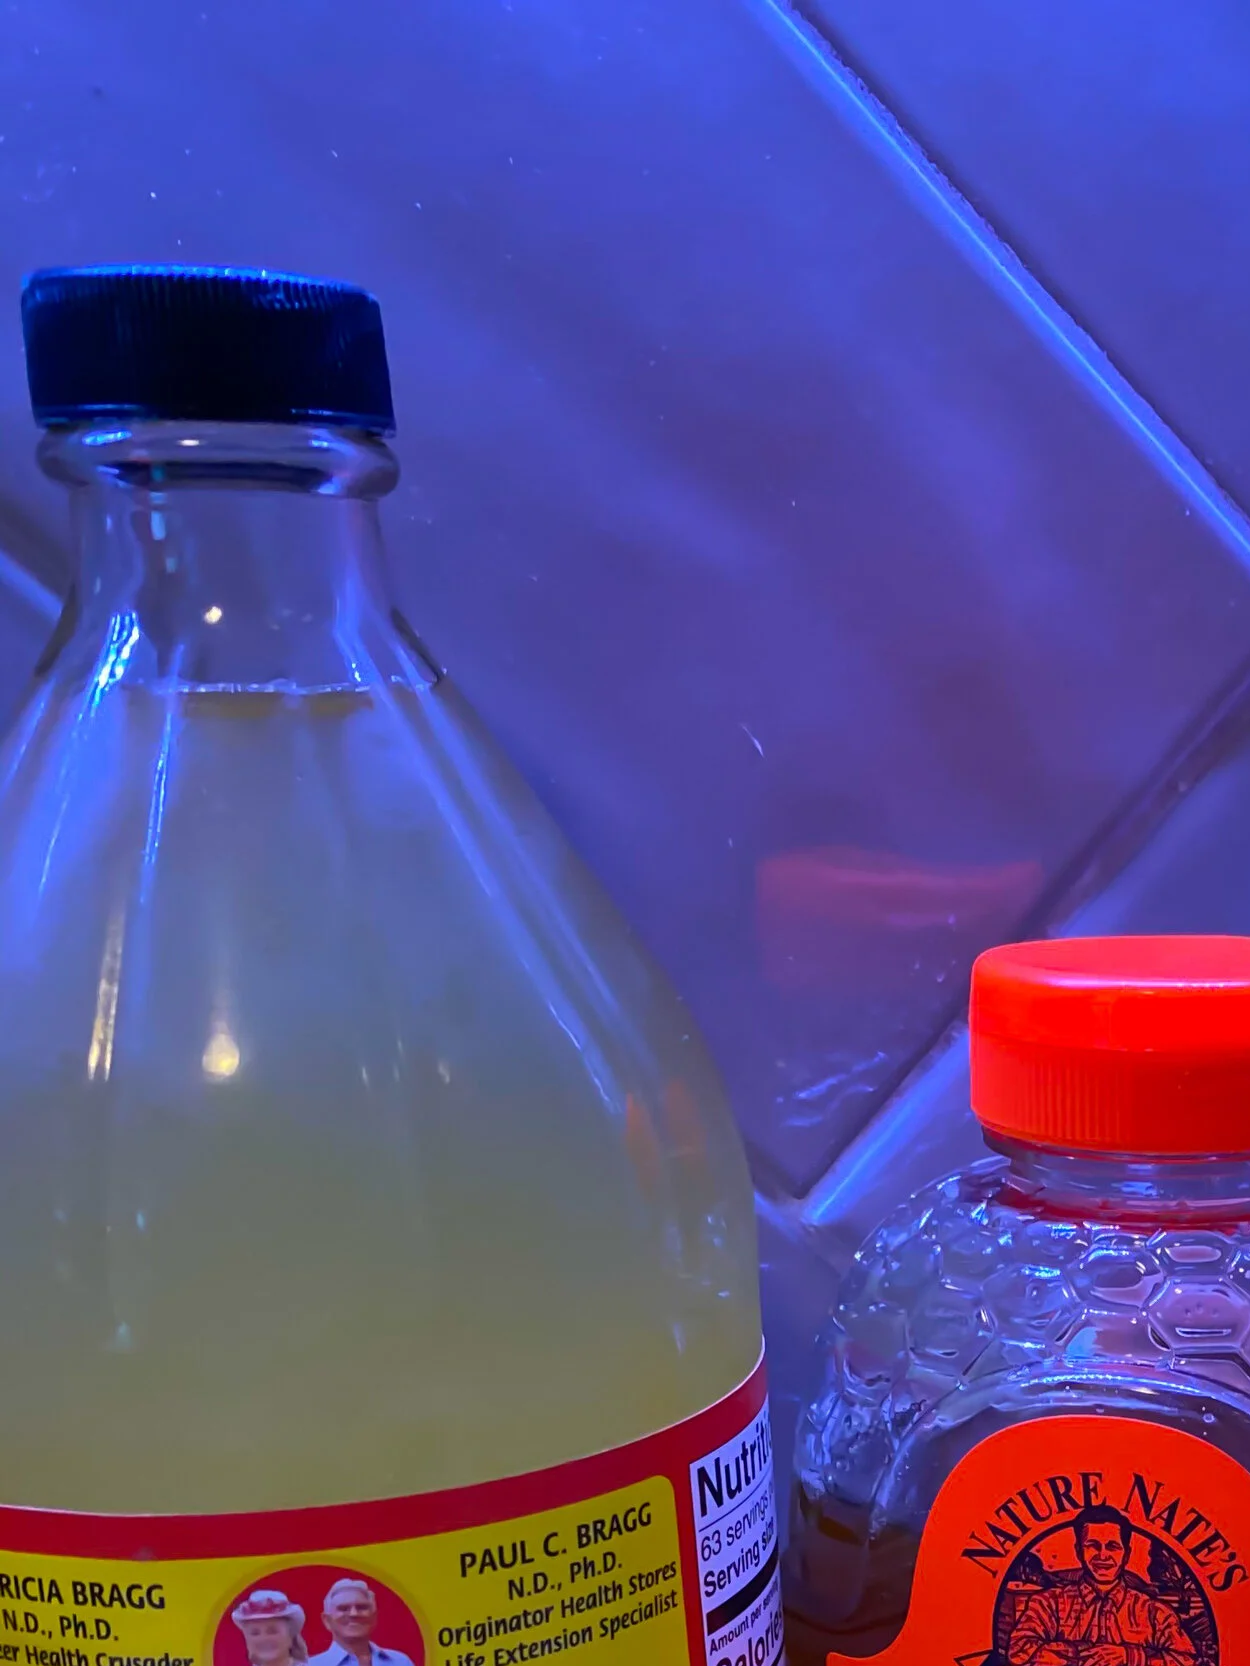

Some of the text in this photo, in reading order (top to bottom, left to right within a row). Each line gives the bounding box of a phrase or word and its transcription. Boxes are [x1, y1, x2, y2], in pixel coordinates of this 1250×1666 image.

[460, 1502, 651, 1577] PAUL C. BRAGG
[702, 1530, 722, 1562] 63
[961, 1472, 1249, 1592] NATURE NATE'S
[508, 1551, 623, 1600] N.D., Ph.D.
[704, 1539, 760, 1597] Serving
[72, 1581, 165, 1609] BRAGG
[438, 1561, 677, 1648] Originator Health Stores
[599, 1591, 679, 1644] Specialist
[3, 1609, 119, 1641] N.D., Ph.D.
[710, 1612, 750, 1655] Amount
[750, 1605, 762, 1625] per
